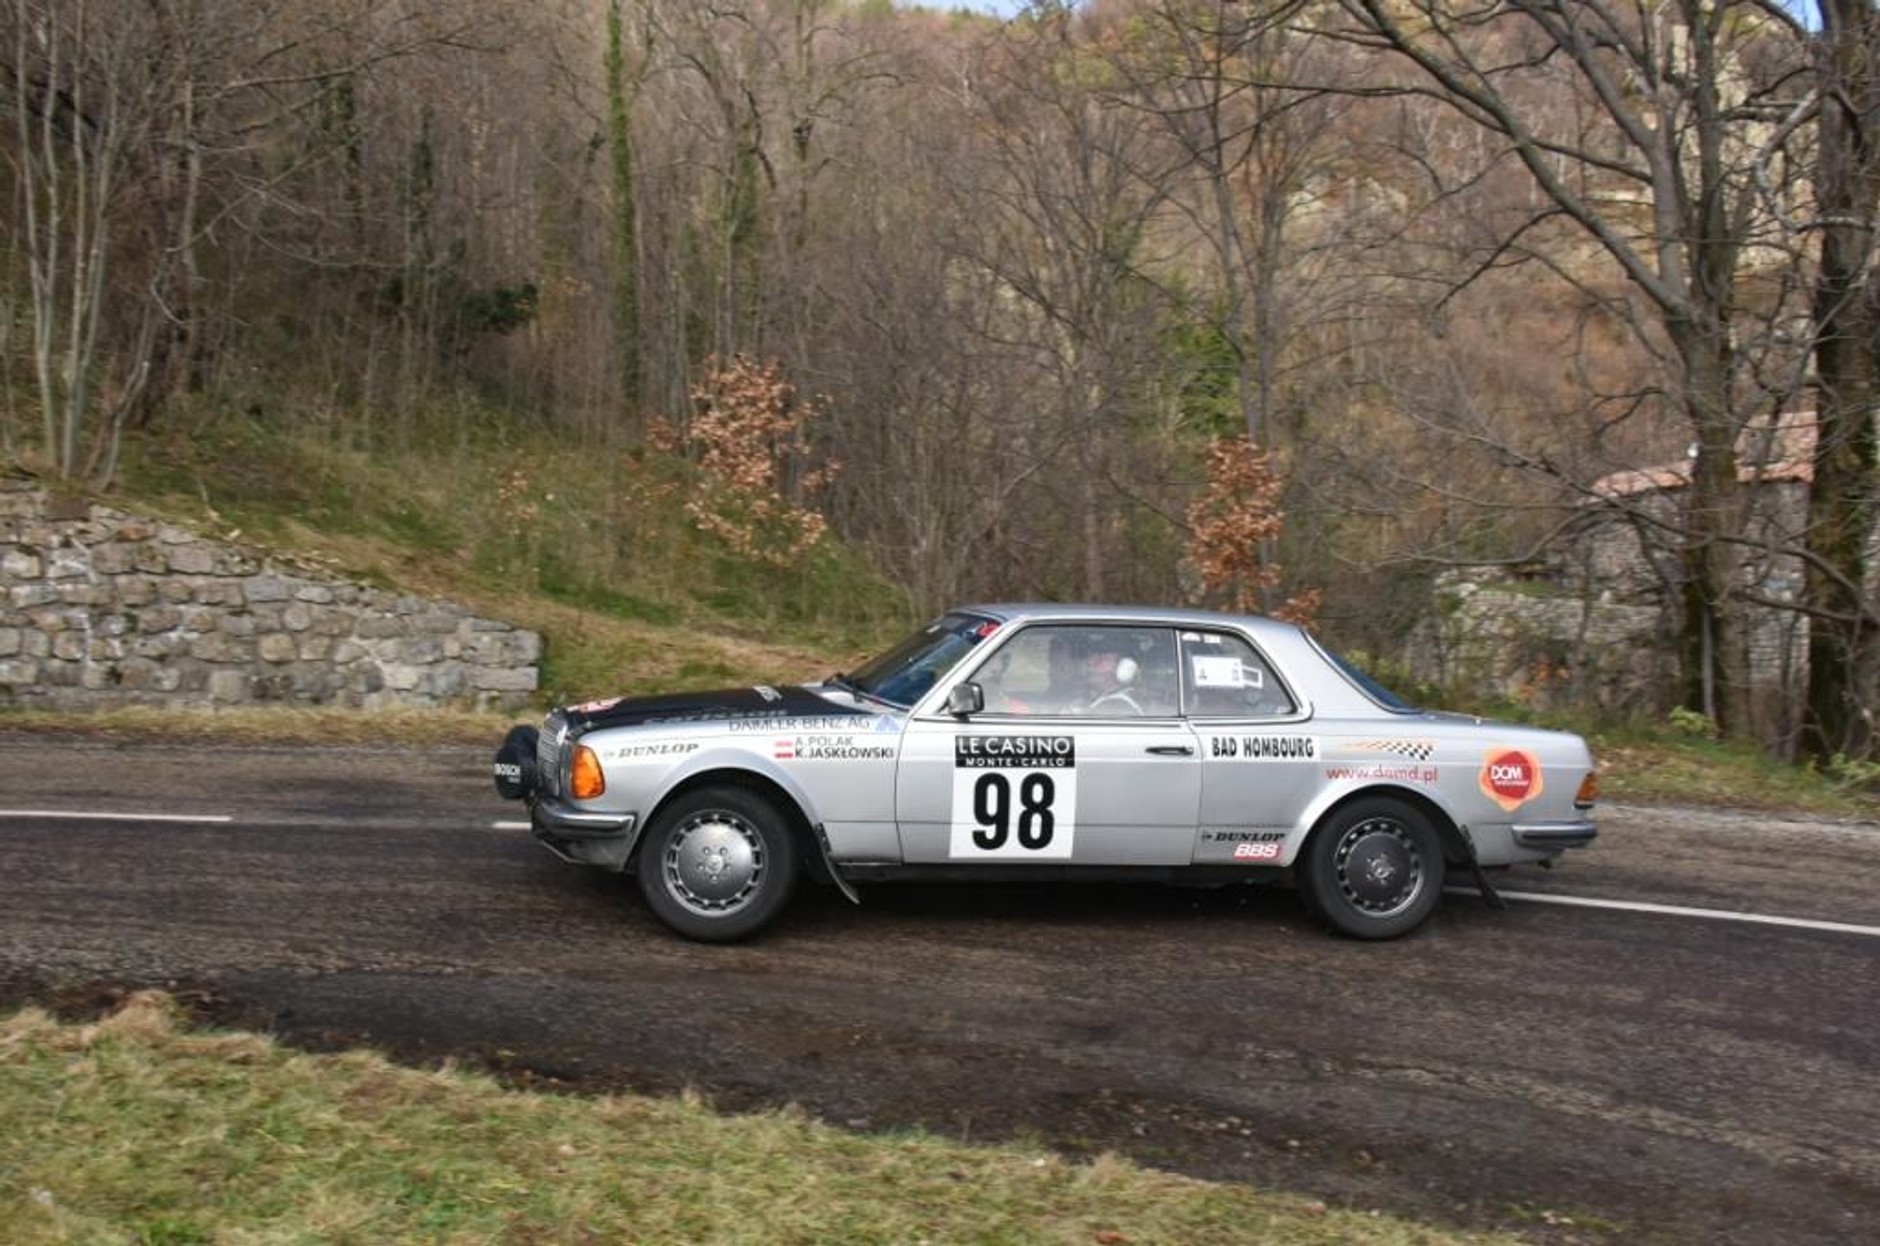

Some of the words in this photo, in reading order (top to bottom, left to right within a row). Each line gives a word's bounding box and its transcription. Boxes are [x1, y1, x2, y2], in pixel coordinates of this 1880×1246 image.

[848, 716, 870, 729] AG
[618, 743, 698, 758] DUNLOP
[958, 738, 981, 754] LE
[985, 738, 1070, 755] CASINO
[1211, 736, 1237, 757] BAD
[1243, 736, 1314, 757] HOMBOURG
[1491, 765, 1522, 780] DOM
[972, 772, 1055, 851] 98
[1214, 832, 1286, 842] DUNLOP
[1233, 843, 1280, 859] BBS
